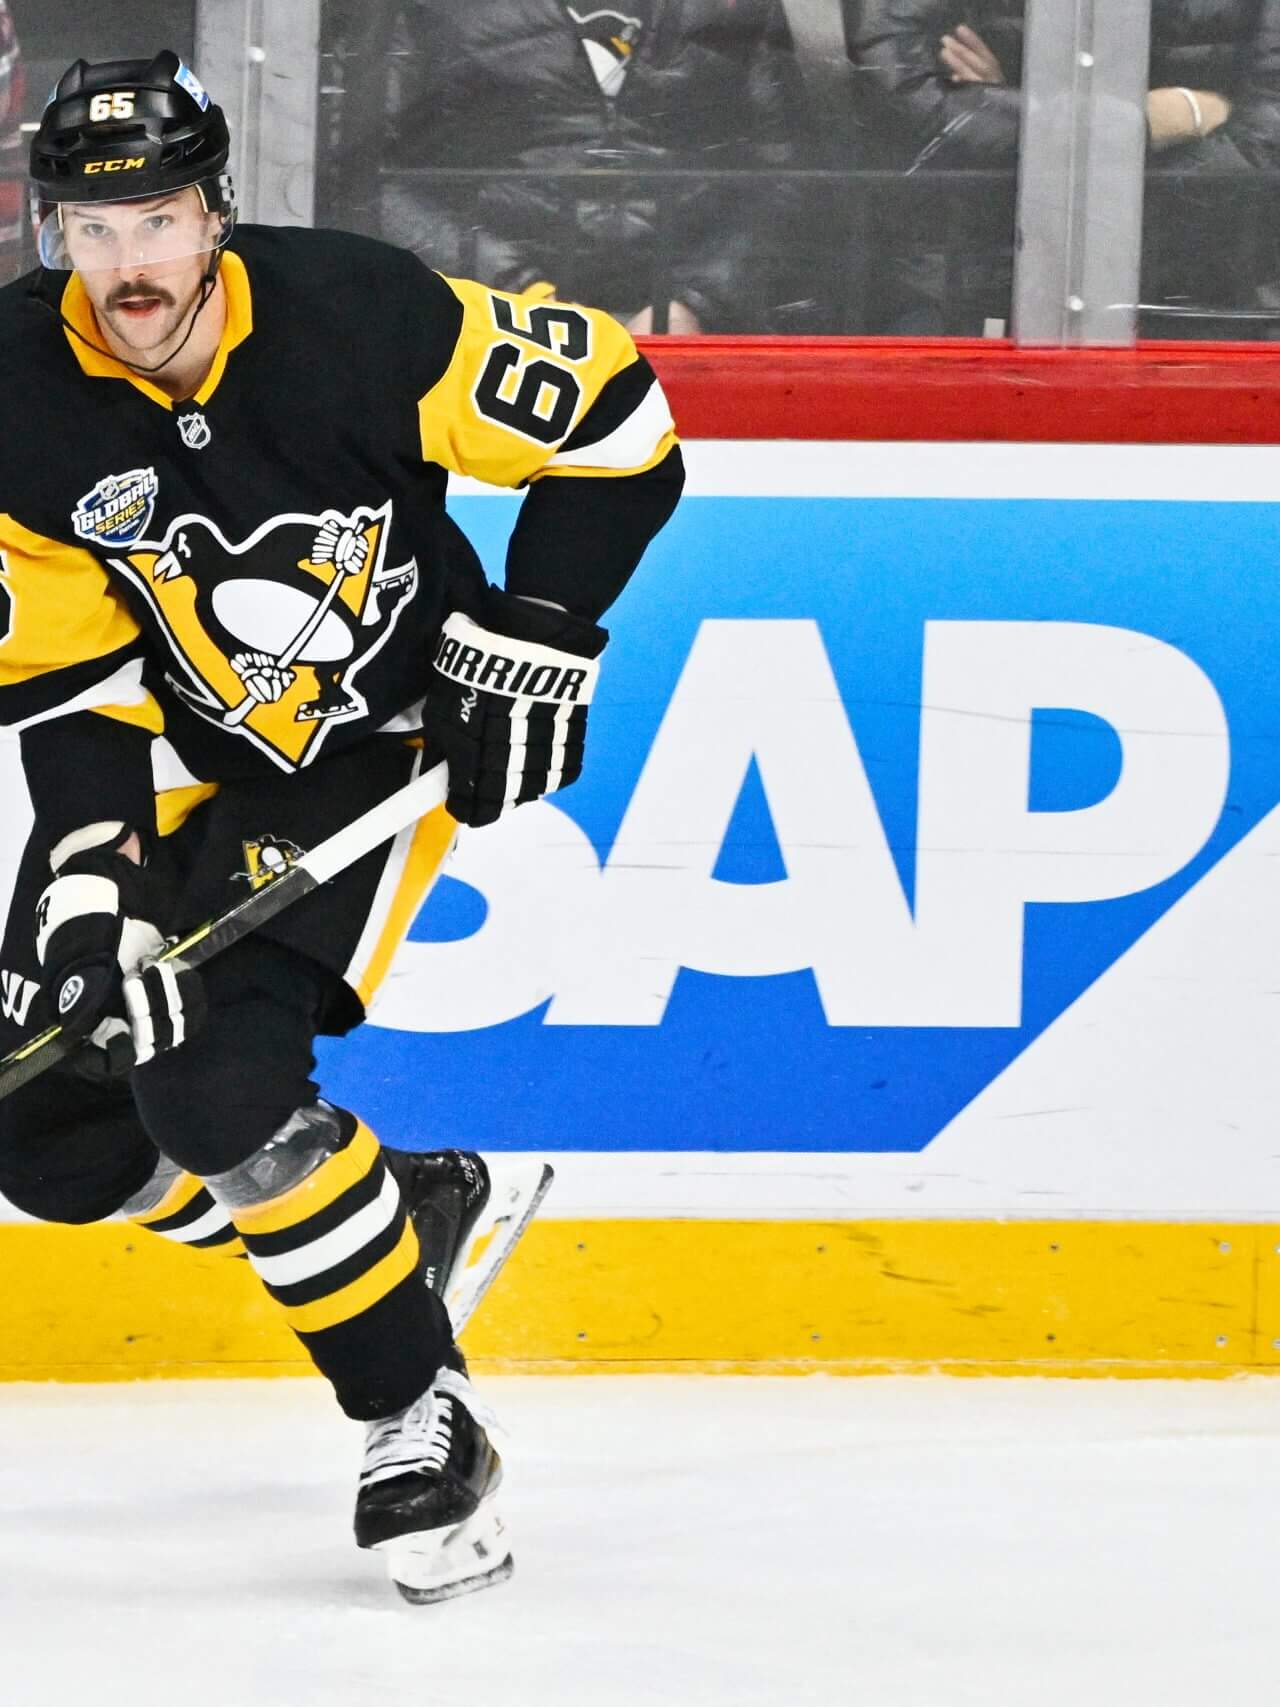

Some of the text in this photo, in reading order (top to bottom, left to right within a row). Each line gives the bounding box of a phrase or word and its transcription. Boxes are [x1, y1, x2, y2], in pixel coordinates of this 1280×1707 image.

[89, 92, 135, 122] 65
[83, 157, 146, 174] CCM
[474, 293, 590, 446] 65
[79, 474, 154, 533] GLOBAL
[95, 496, 145, 535] SERIES
[434, 633, 588, 701] ARRIOR
